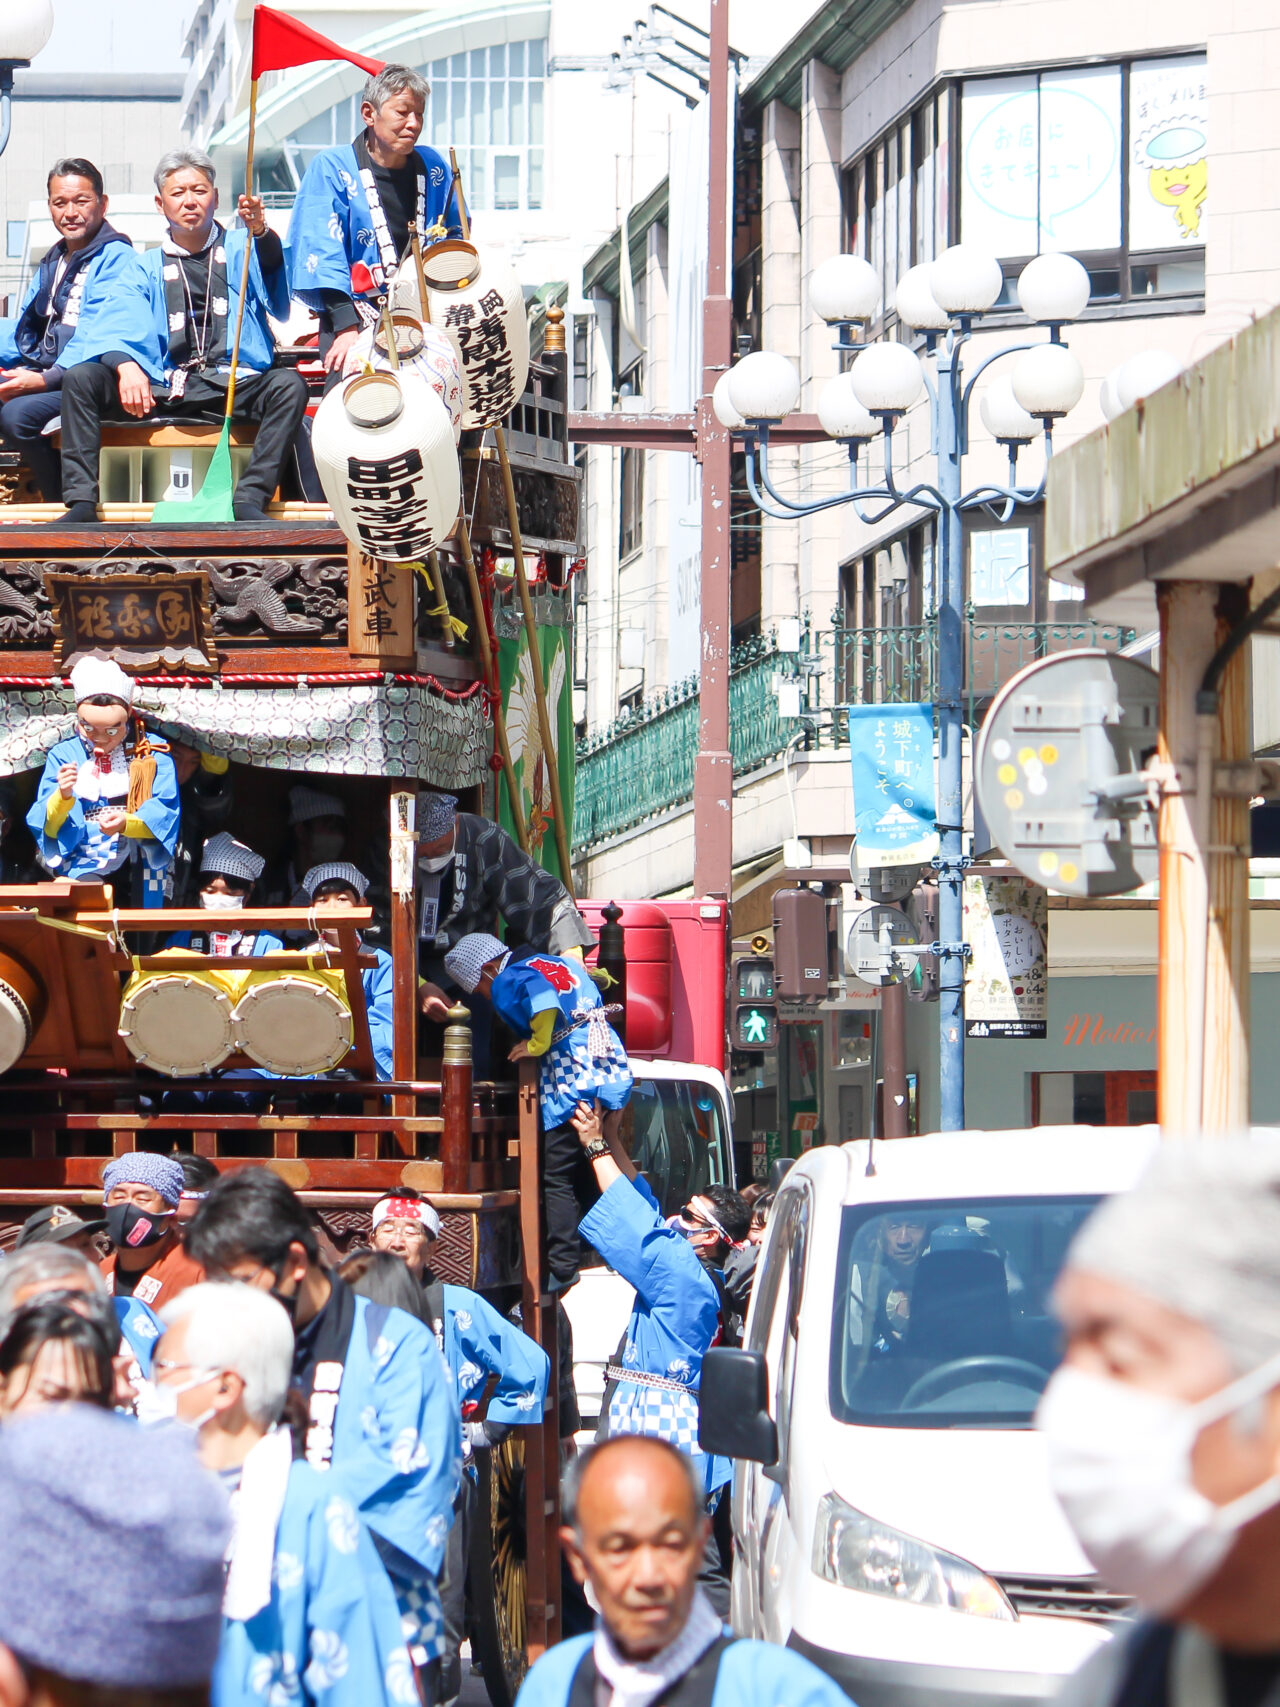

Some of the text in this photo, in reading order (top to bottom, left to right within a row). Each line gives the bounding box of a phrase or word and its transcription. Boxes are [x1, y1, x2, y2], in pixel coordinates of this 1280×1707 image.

[874, 719, 891, 796] ようこそ
[892, 719, 915, 791] 城下町へ
[1014, 927, 1024, 965] おいしい
